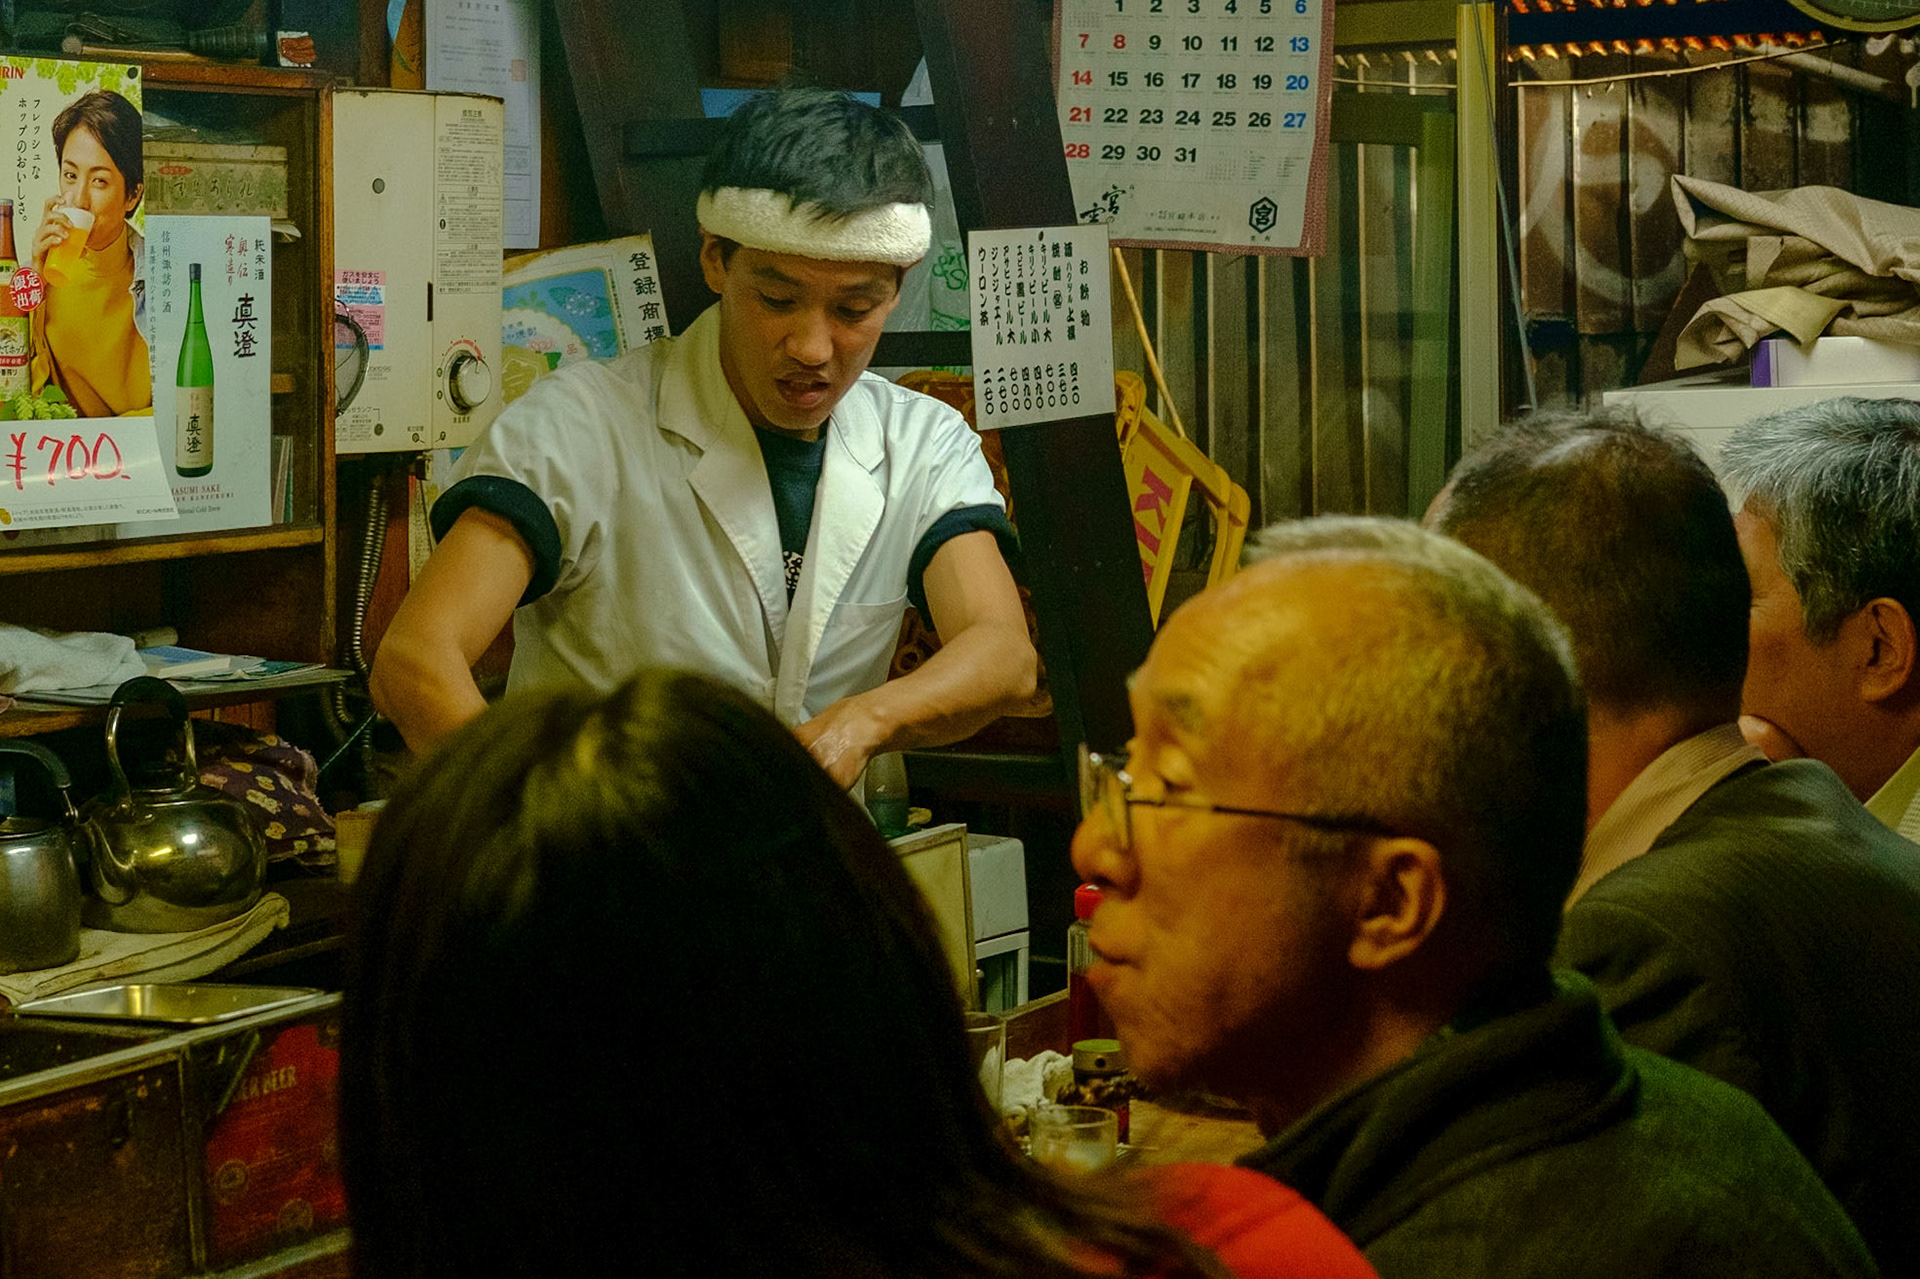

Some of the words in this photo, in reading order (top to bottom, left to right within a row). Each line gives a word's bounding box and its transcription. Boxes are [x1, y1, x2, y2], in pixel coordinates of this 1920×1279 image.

[1115, 0, 1124, 12] 1
[1150, 0, 1162, 12] 2
[1187, 0, 1200, 13] 3
[1225, 0, 1237, 14] 4
[1260, 0, 1271, 14] 5
[1295, 0, 1307, 14] 6
[1078, 33, 1089, 48] 7
[1113, 34, 1126, 49] 8
[1149, 35, 1161, 50] 9
[1182, 35, 1202, 50] 10
[1220, 36, 1237, 51] 11
[1254, 36, 1274, 52] 12
[1289, 37, 1310, 52] 13
[1072, 70, 1092, 85] 14
[1108, 71, 1128, 86] 15
[1144, 72, 1164, 87] 16
[1181, 73, 1201, 88] 17
[1216, 74, 1236, 89] 18
[1252, 74, 1272, 90] 19
[1286, 75, 1309, 90] 20
[32, 99, 41, 179] フレッシュな
[1069, 106, 1091, 123] 21
[1103, 108, 1128, 123] 22
[1139, 109, 1164, 124] 23
[1175, 110, 1201, 126] 24
[1212, 111, 1236, 126] 25
[1248, 112, 1271, 127] 26
[1283, 112, 1307, 128] 27
[16, 98, 28, 222] ホップのおいしさ。
[1065, 143, 1090, 159] 28
[1101, 144, 1125, 160] 29
[1136, 146, 1161, 161] 30
[1174, 147, 1197, 163] 31
[13, 272, 40, 291] 限定
[15, 288, 42, 308] 出荷
[629, 251, 668, 342] 登録商標
[979, 246, 989, 326] ウーロン茶
[1003, 245, 1016, 344] アサヒビール大
[1029, 244, 1040, 343] キリンビール小
[1040, 244, 1052, 342] キリンビール大
[1080, 259, 1090, 327] お飲物
[232, 293, 258, 358] 真澄
[185, 413, 202, 453] 真澄
